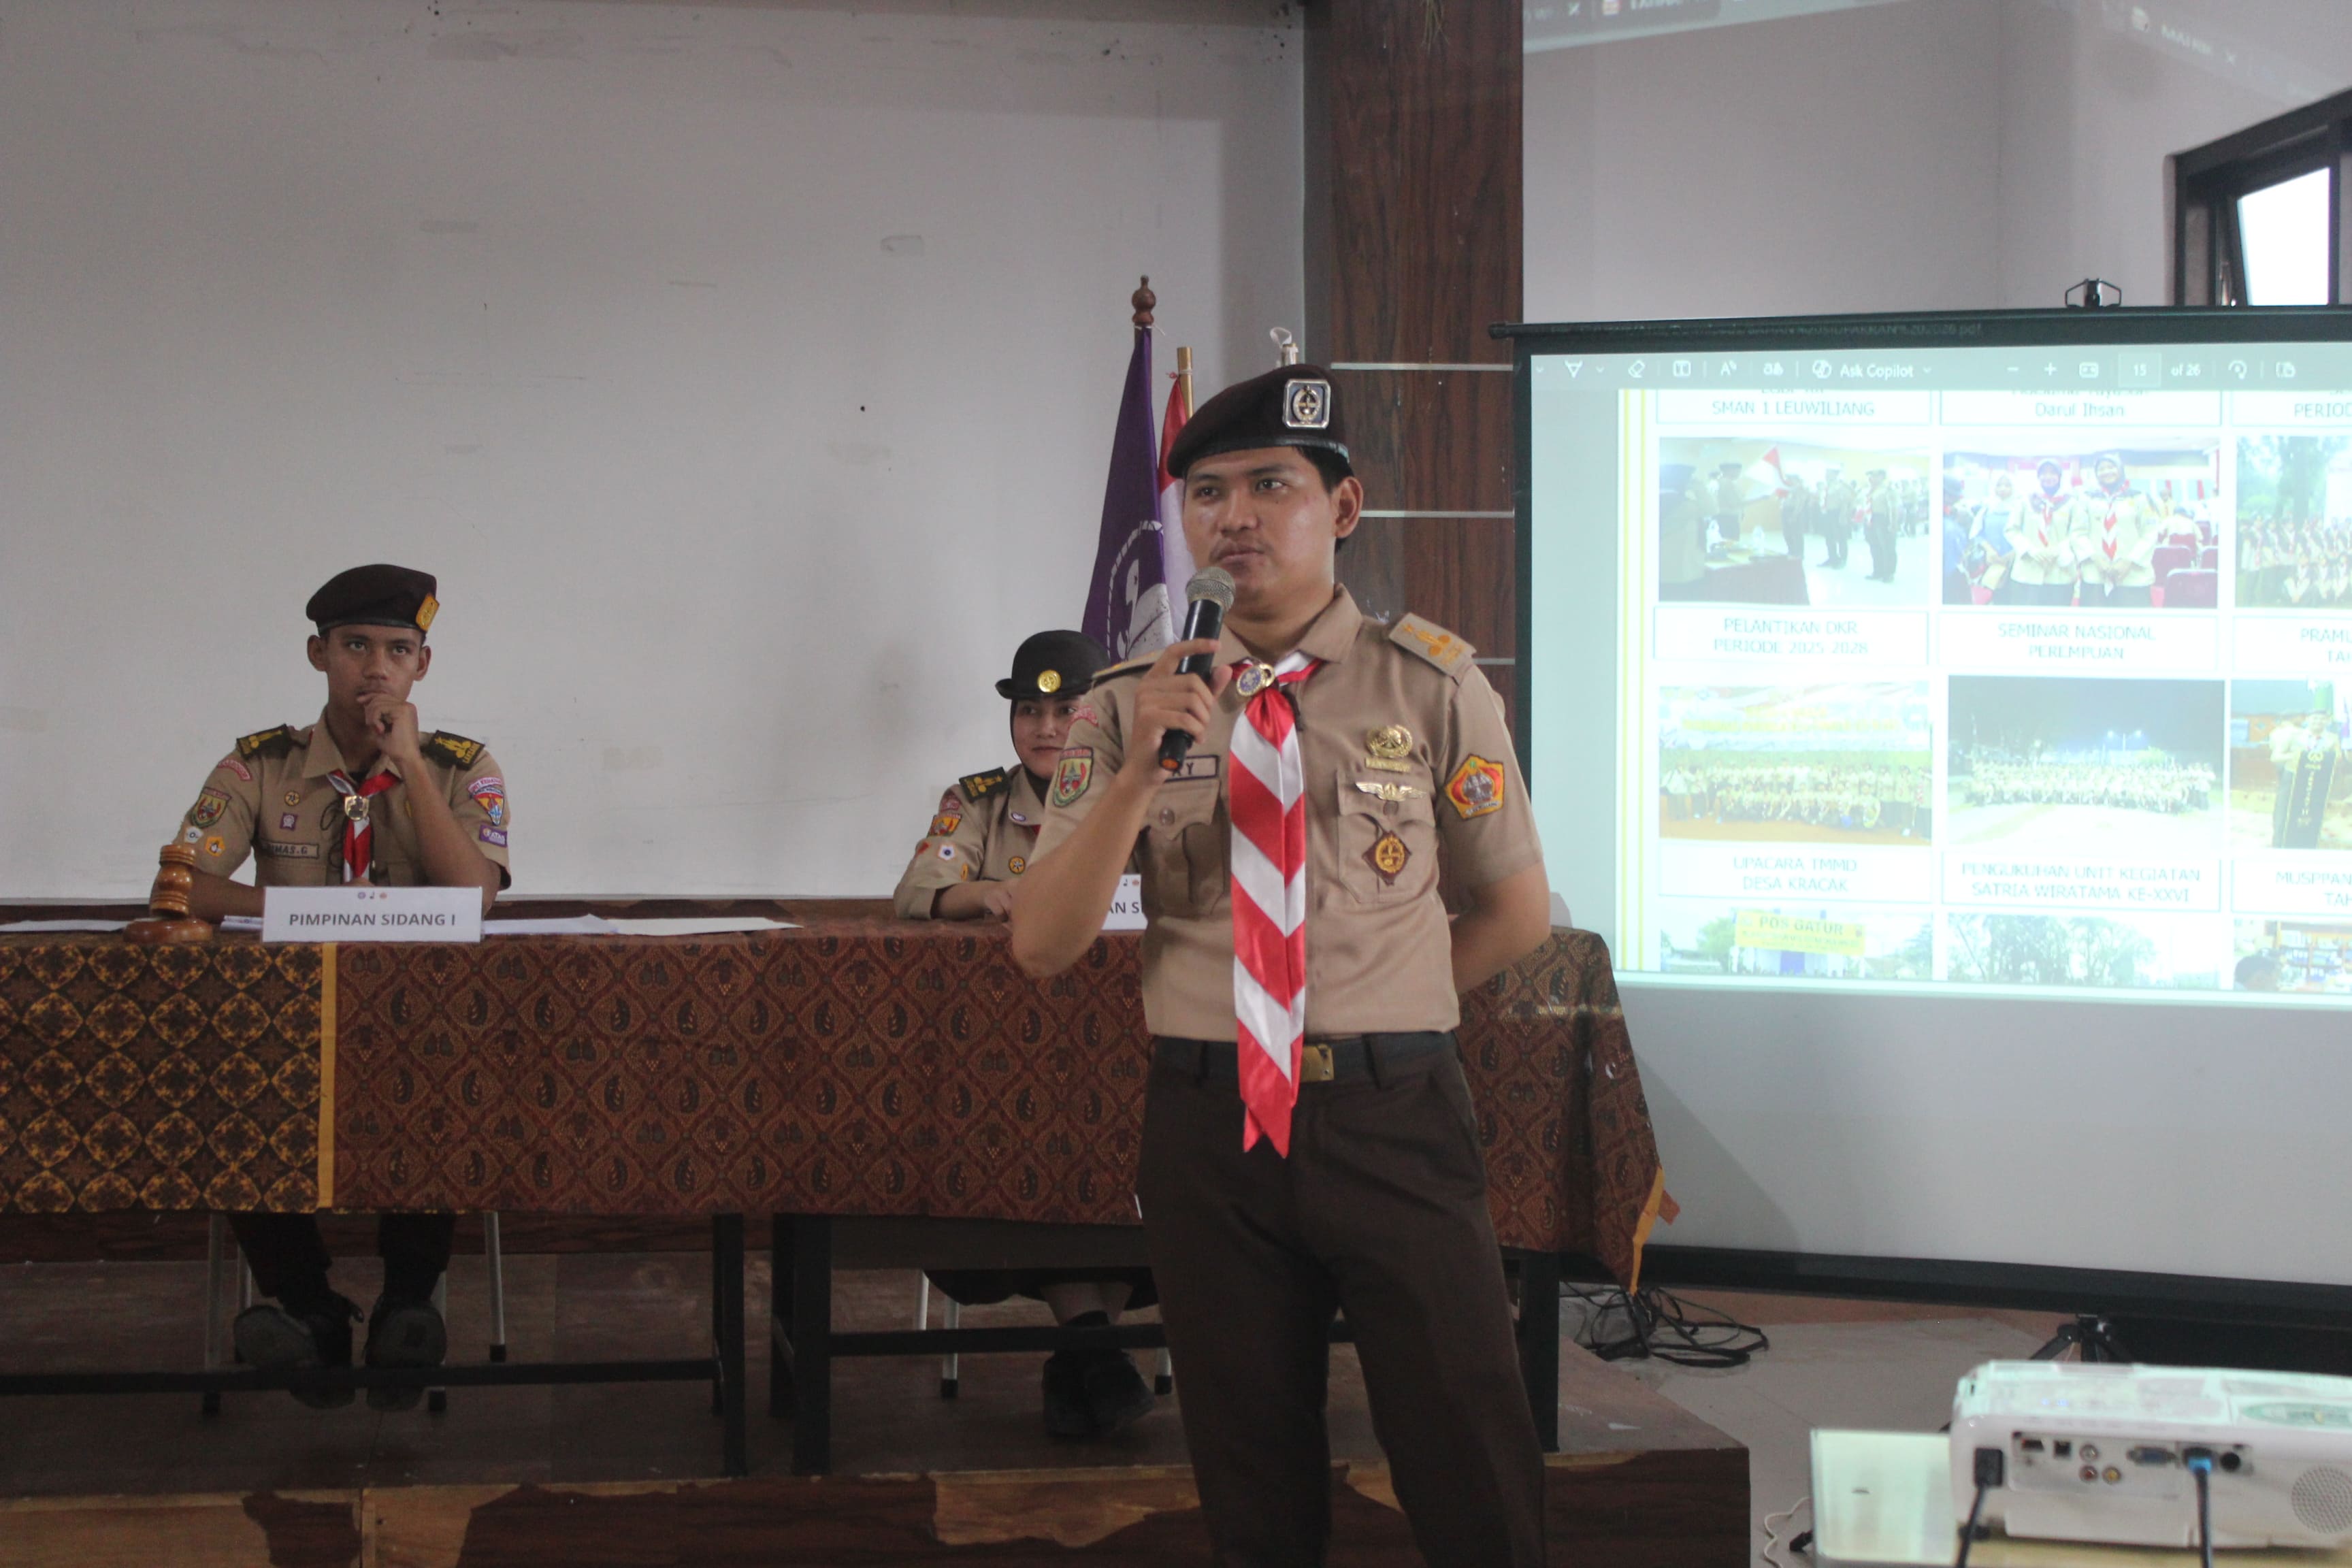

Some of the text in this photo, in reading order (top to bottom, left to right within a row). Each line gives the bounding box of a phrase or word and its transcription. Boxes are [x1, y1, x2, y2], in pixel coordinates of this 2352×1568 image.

[1840, 362, 1914, 380] Ask Copilot
[2134, 363, 2201, 376] 15 of 26
[1712, 400, 1754, 414] SMAN
[1776, 400, 1875, 416] LEUWILIANG
[2035, 402, 2125, 417] Darul Ihsan
[1724, 617, 1859, 635] PELANTIKAN DKR
[1997, 623, 2157, 641] SEMINAR NASIONAL
[1714, 638, 1781, 653] PERIODE
[2028, 644, 2125, 659] PEREMPUAN
[1733, 856, 1858, 872] UPACARA TMMD
[1961, 862, 2201, 883] PENGUKUHAN UNIT KEGIATAN
[1742, 876, 1849, 893] DESA KRACAK
[1971, 882, 2191, 902] SATRIA WIRATAMA KE-XXVI
[289, 913, 376, 926] PIMPINAN
[380, 913, 446, 926] SIDANG
